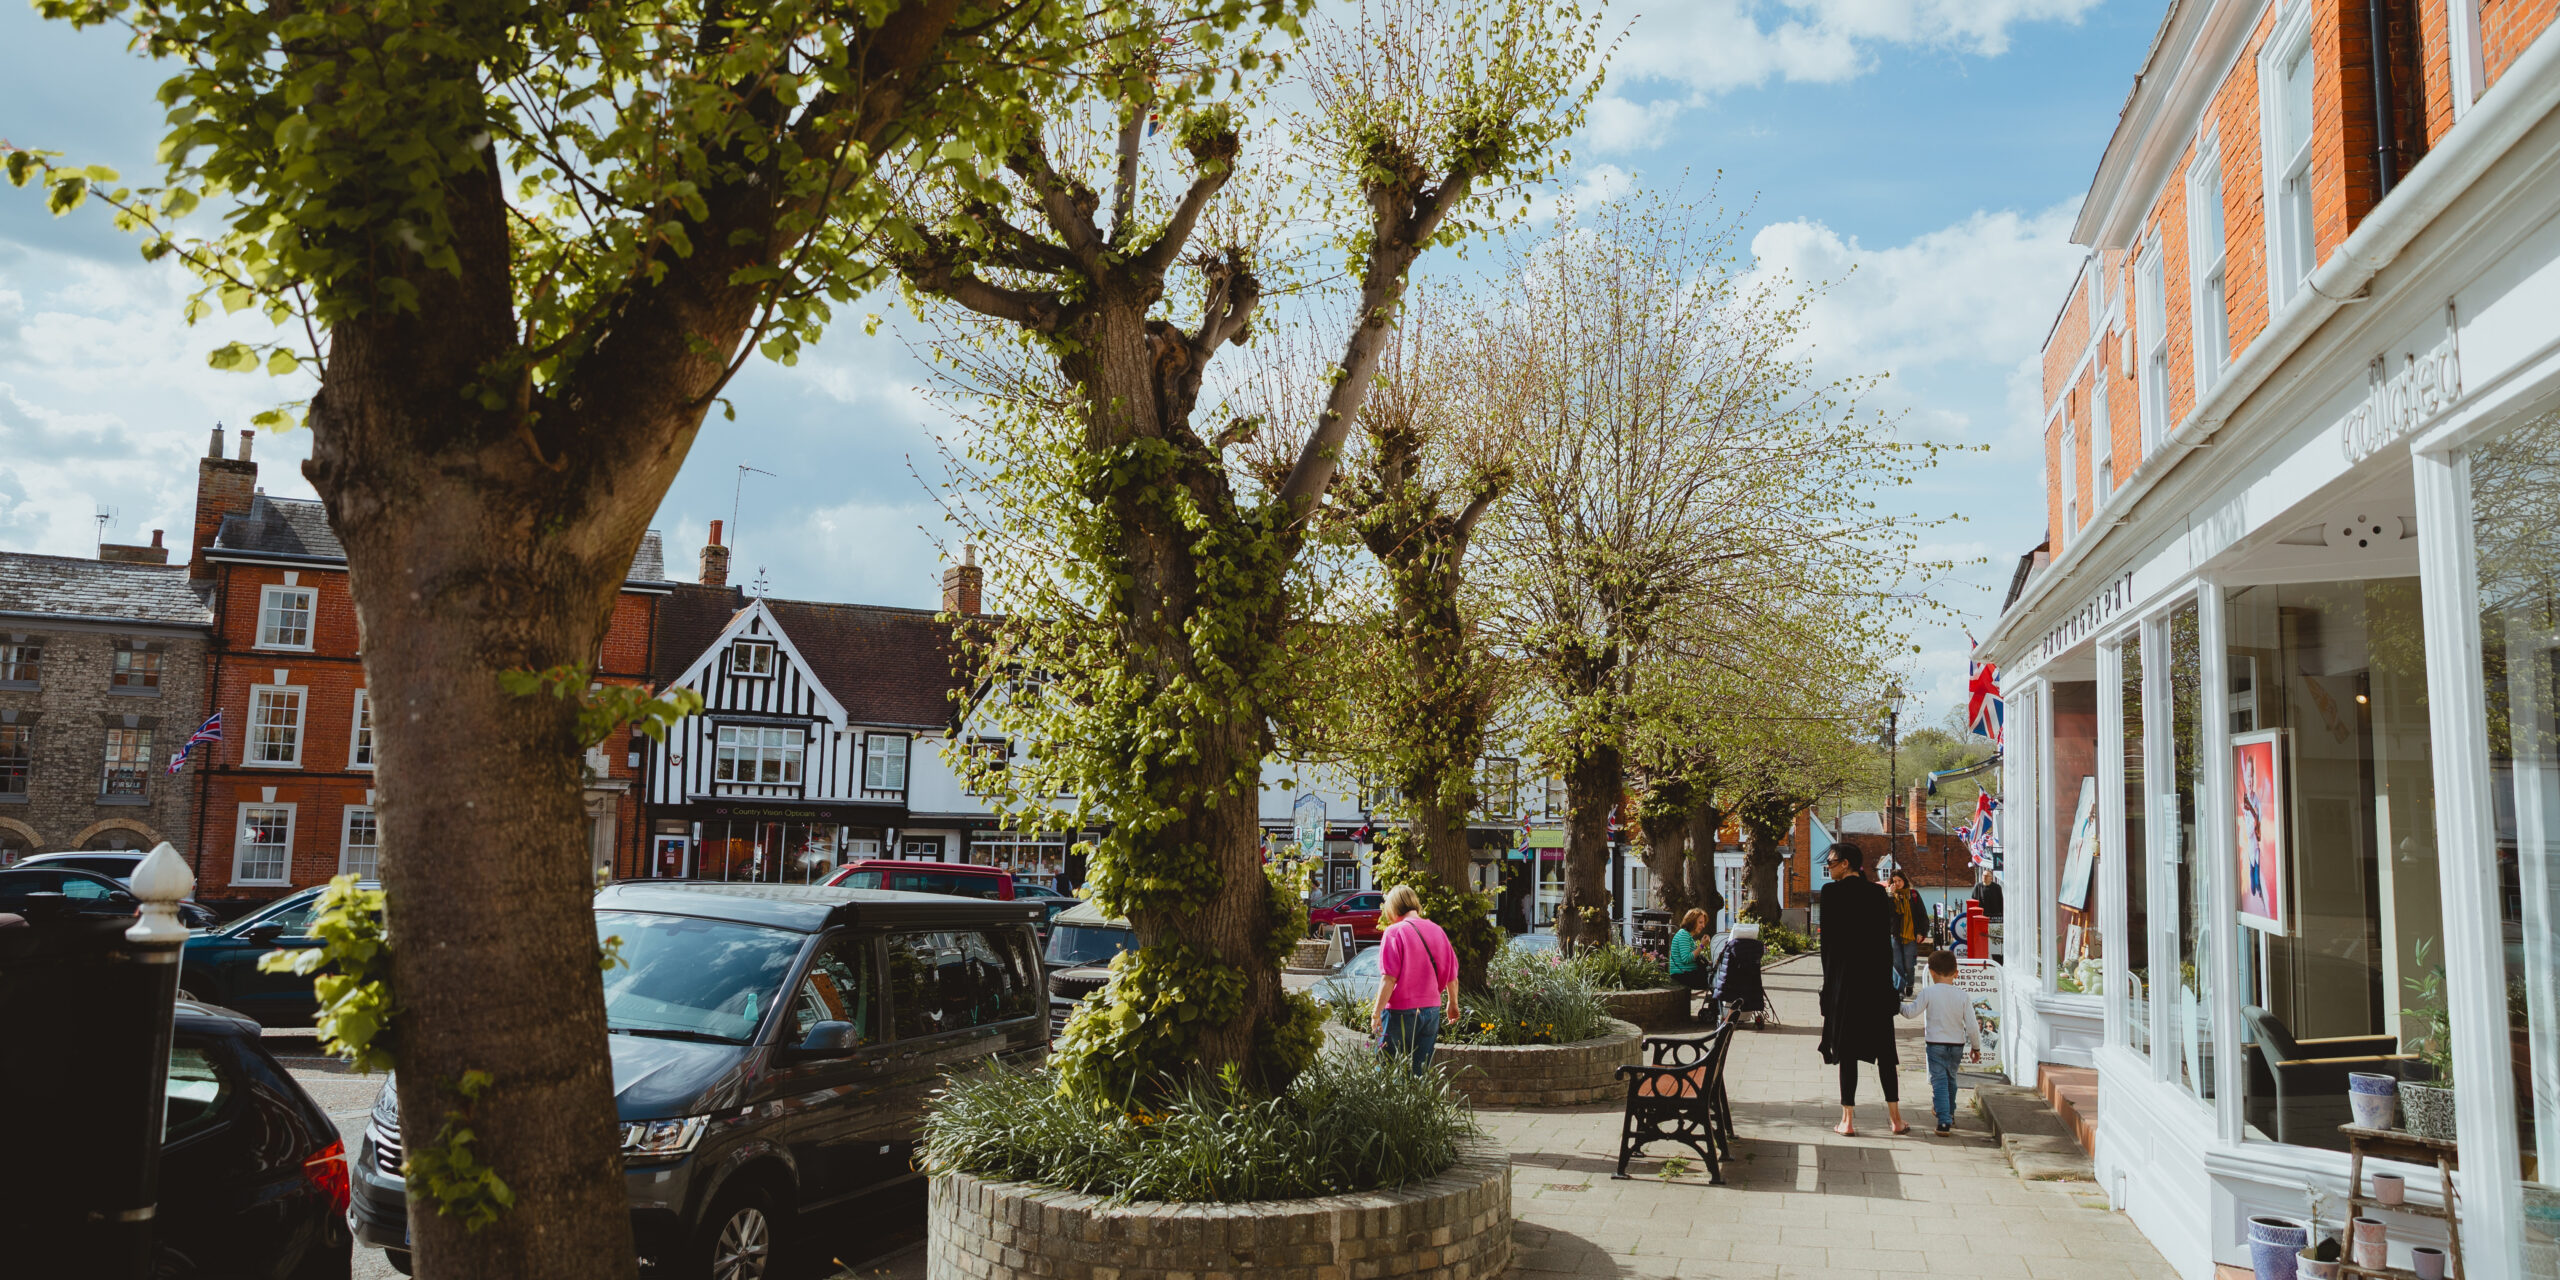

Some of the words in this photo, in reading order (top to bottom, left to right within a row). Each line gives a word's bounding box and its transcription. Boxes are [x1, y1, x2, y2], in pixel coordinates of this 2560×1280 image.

[2341, 295, 2462, 466] collated
[2043, 571, 2132, 659] PHOTOGRAPHY
[733, 808, 760, 816] Country
[763, 808, 783, 816] Vision
[785, 809, 815, 817] Opticians
[1636, 938, 1665, 946] LITTR
